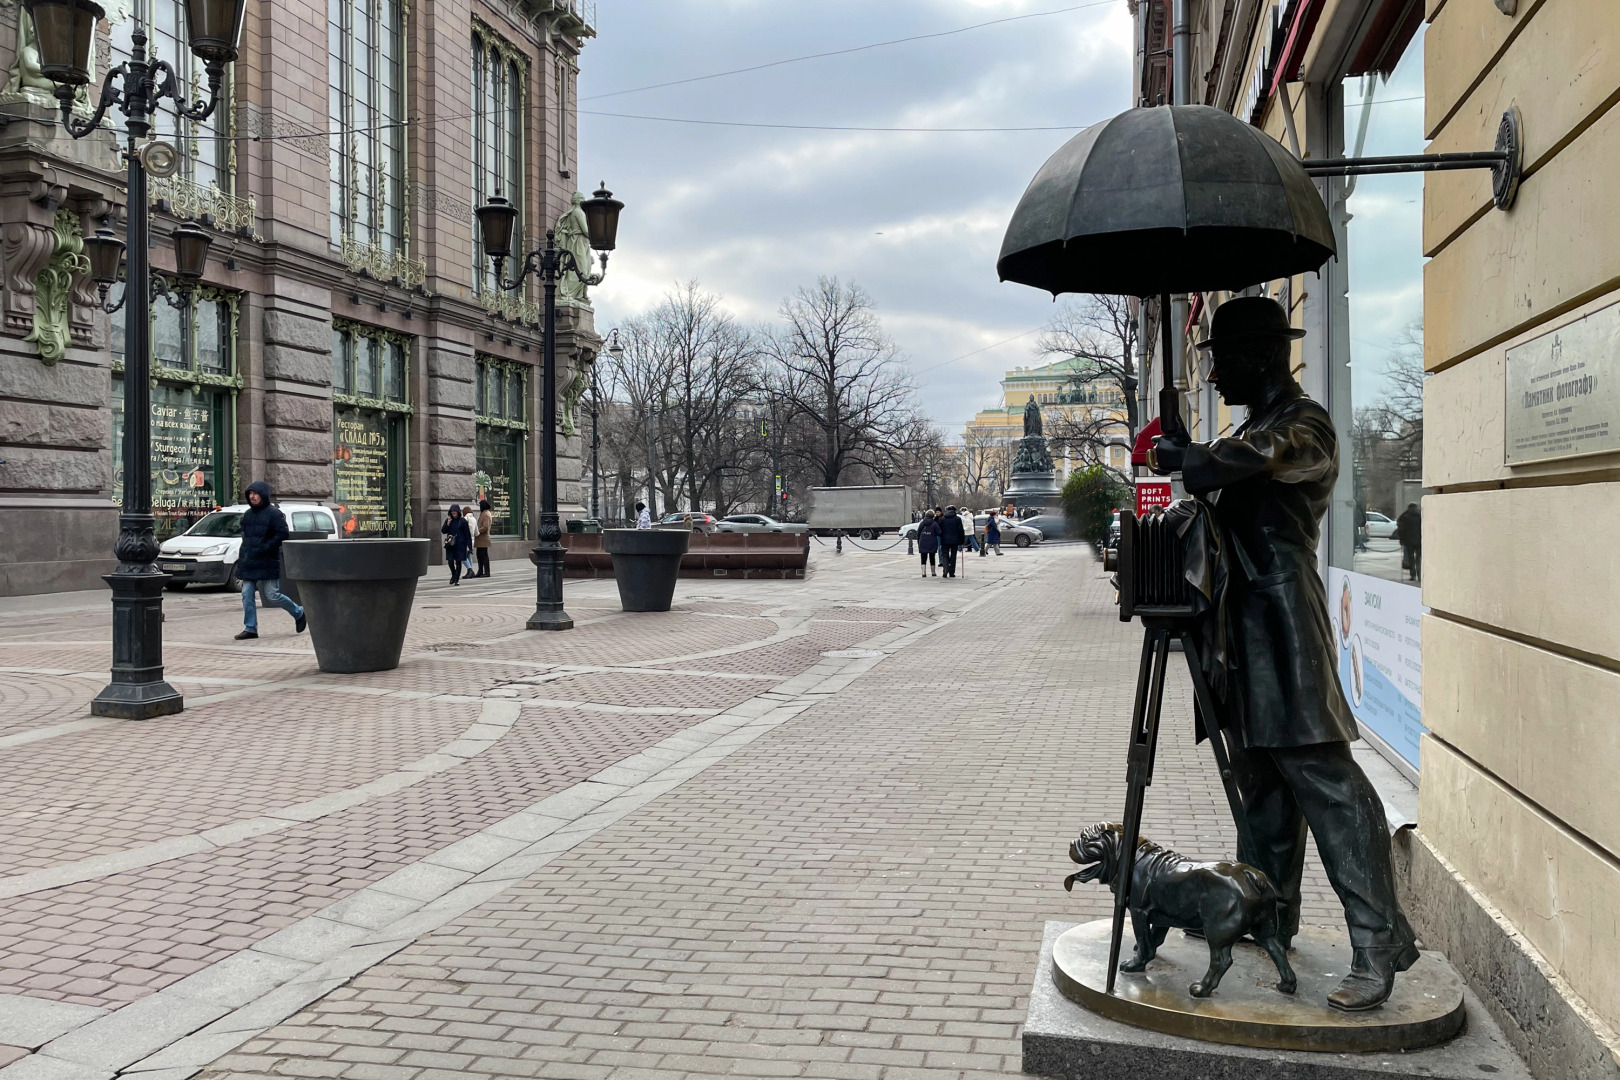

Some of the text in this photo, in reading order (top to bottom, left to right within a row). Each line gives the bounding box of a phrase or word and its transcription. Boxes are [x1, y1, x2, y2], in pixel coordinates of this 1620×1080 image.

[151, 404, 177, 417] Caviar
[337, 419, 363, 430] Ресторан
[155, 442, 186, 454] Sturgeon
[161, 455, 181, 464] Sevruga
